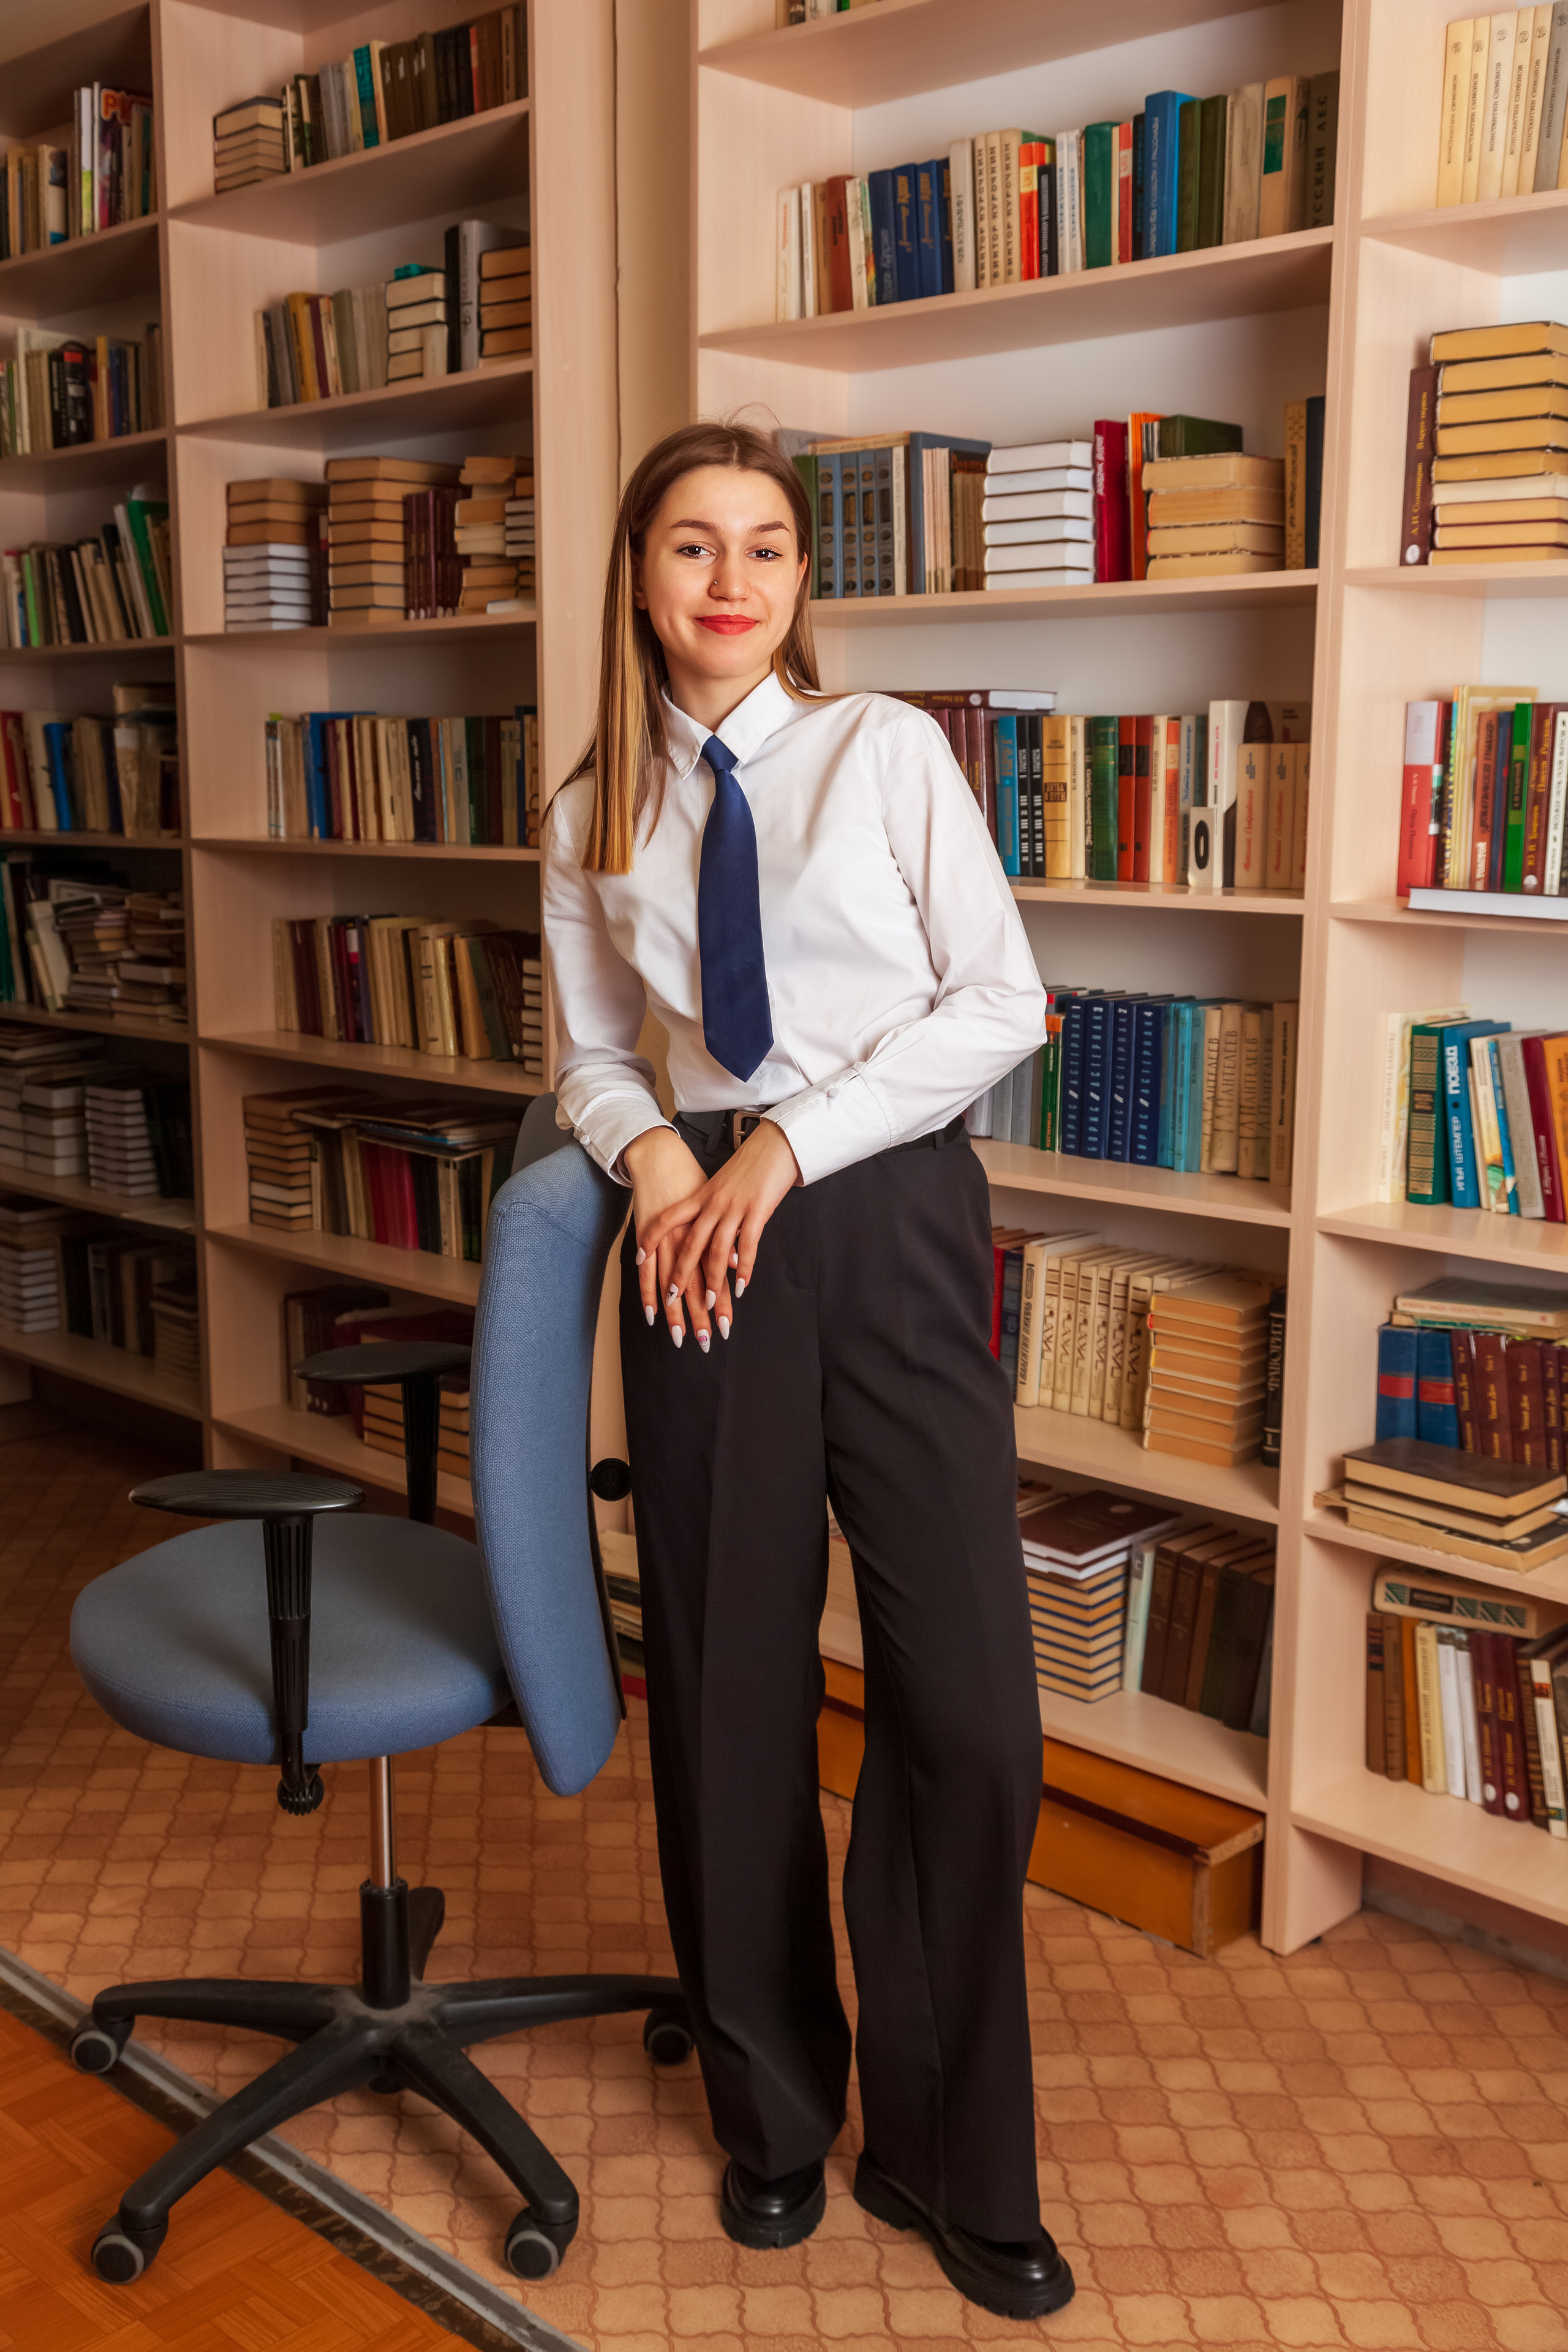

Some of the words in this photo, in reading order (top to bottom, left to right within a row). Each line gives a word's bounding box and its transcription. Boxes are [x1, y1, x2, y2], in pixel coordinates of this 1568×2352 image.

[1493, 61, 1502, 99] СИМОНОВ
[1514, 64, 1523, 102] СИМОНОВ
[1546, 86, 1557, 138] КОНСТАНТИН
[1552, 47, 1561, 85] СИМОНОВ
[1490, 101, 1498, 152] КОНСТАНТИН
[1525, 100, 1536, 152] КОНСТАНТИН
[1531, 59, 1541, 97] СИМОНОВ
[1447, 113, 1456, 165] КОНСТАНТИН
[1468, 111, 1476, 162] КОНСТАНТИН
[1510, 104, 1520, 155] КОНСТАНТИН
[1001, 735, 1013, 776] КРУГ
[1475, 842, 1487, 878] ТОЛСТОЙ
[1526, 855, 1535, 867] Ю.
[1069, 1014, 1080, 1099] ПАСТЕРНАК
[1090, 1015, 1102, 1101] ПАСТЕРНАК
[1114, 1018, 1128, 1103] ПАСТЕРНАК
[1139, 1020, 1153, 1107] ПАСТЕРНАК
[1216, 1030, 1238, 1110] ПАНТЕЛЕЕВ
[1387, 1031, 1396, 1070] БАМБУКЕ
[1445, 1045, 1461, 1095] ПОЕЗД
[1239, 1038, 1258, 1117] ПАНТЕЛЕЕВ
[1387, 1072, 1394, 1084] НА
[1066, 1104, 1077, 1149] БОРИС
[1088, 1106, 1099, 1152] БОРИС
[1112, 1110, 1123, 1155] БОРИС
[1137, 1114, 1148, 1160] БОРИС
[1383, 1110, 1392, 1131] ЗНАК
[1452, 1115, 1464, 1163] ШТЕМЛЕР
[1457, 1167, 1465, 1191] ИЛЬЯ
[1022, 1302, 1032, 1335] ПИКУЛЬ
[1020, 1335, 1030, 1381] ВАЛЕНТИН
[1268, 1321, 1284, 1391] ФАВОРИТ
